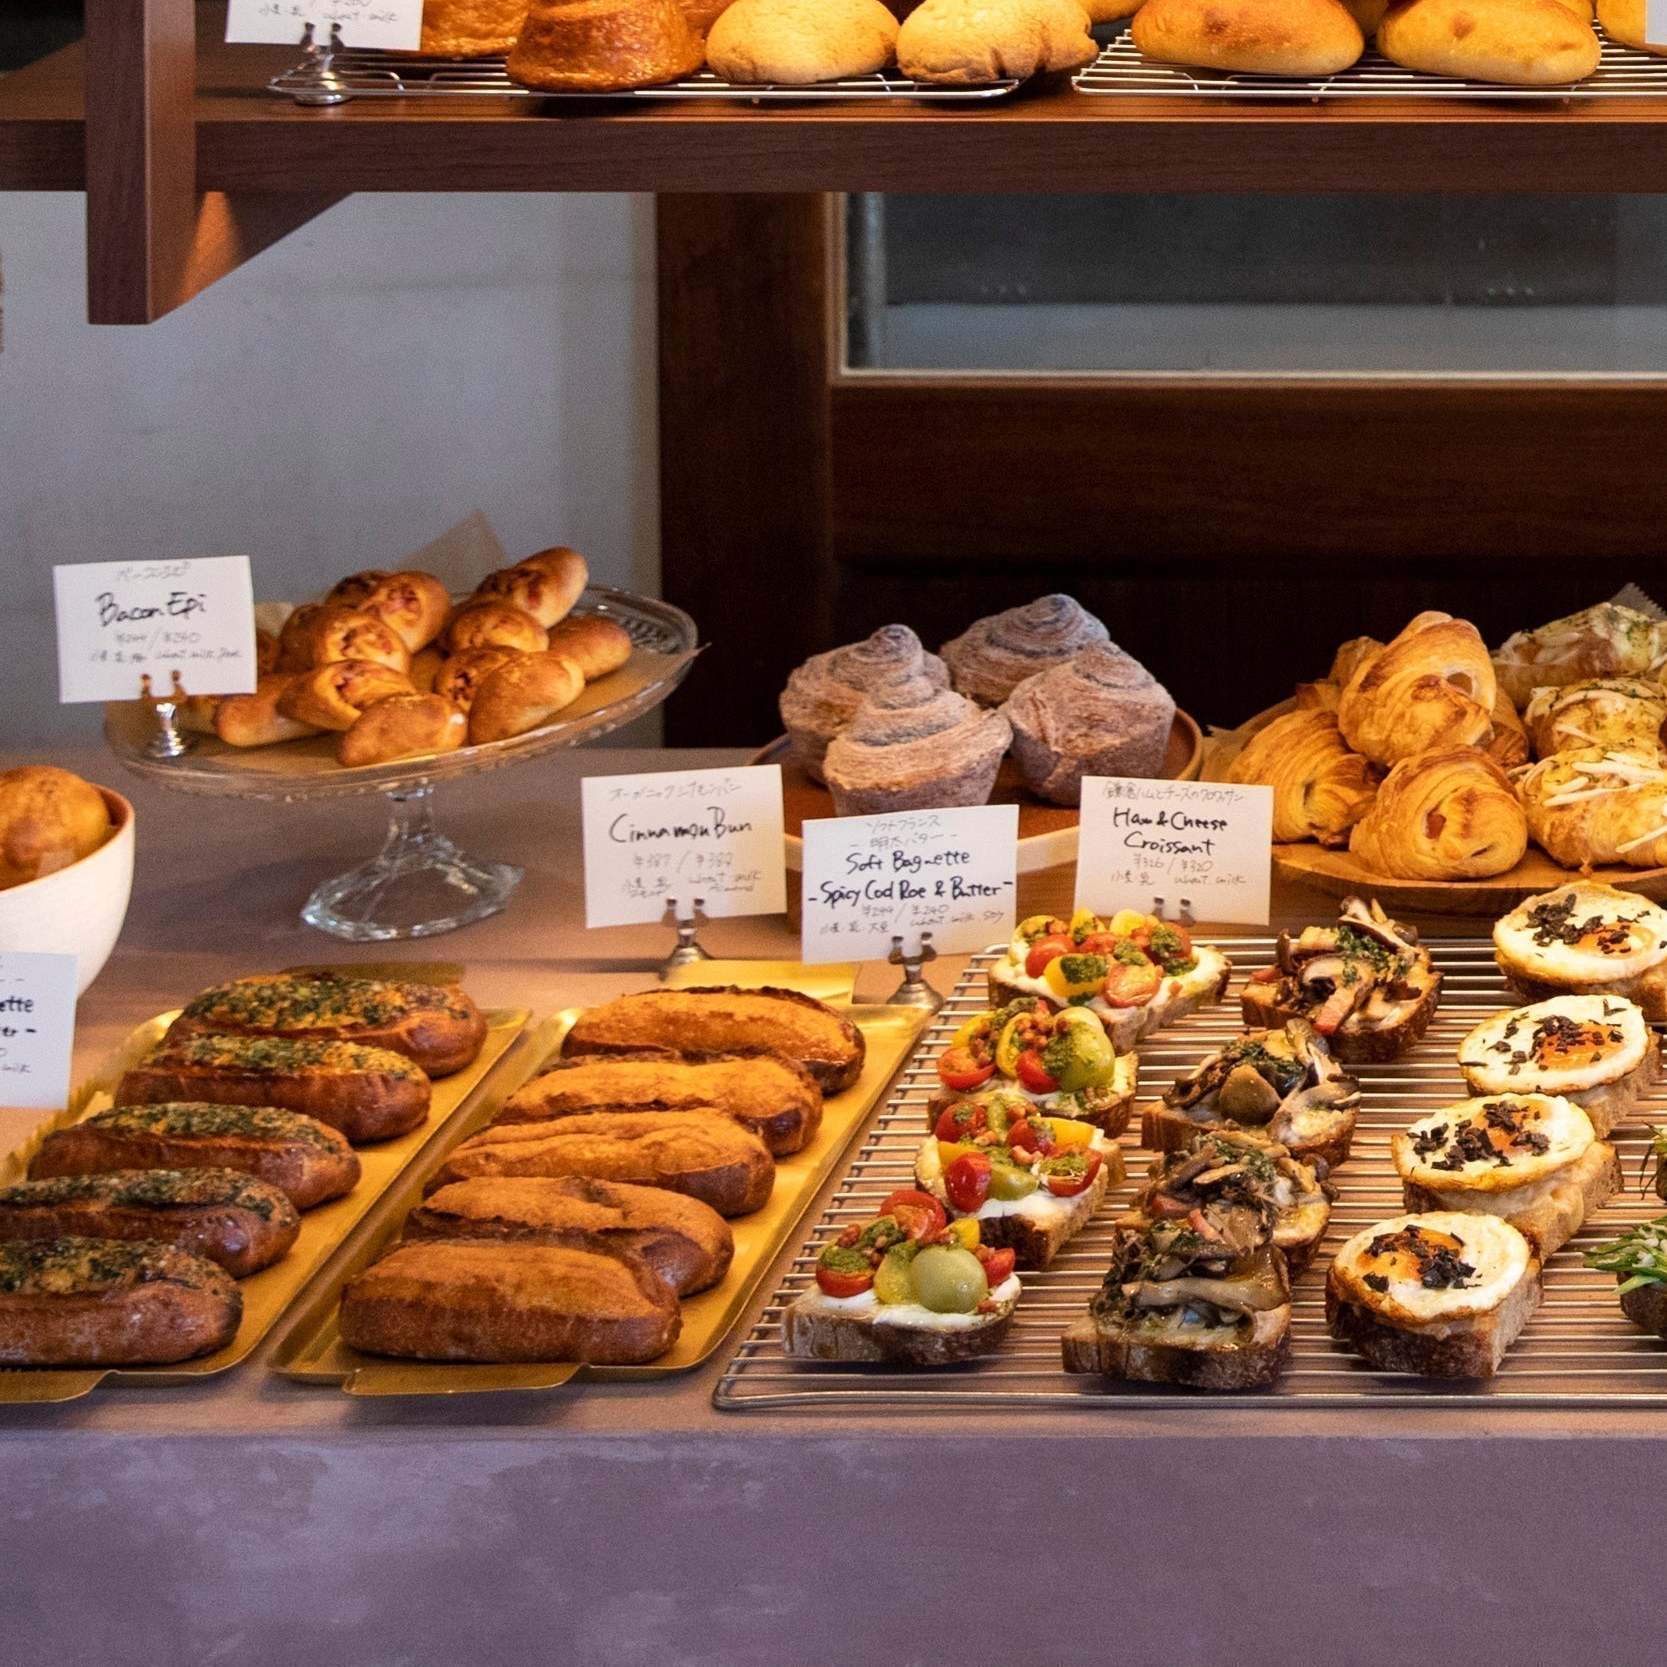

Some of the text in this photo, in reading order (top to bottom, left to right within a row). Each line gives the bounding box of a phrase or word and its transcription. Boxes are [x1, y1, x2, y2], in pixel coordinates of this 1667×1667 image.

[95, 591, 206, 627] Bacon Epi
[609, 806, 752, 843] Cinnamon Bun
[1113, 807, 1228, 831] Ham & Cheese
[1124, 831, 1215, 855] Croissant
[846, 851, 970, 875] Soft Baguette
[821, 876, 1002, 909] Spicy Cod Roe & Butter
